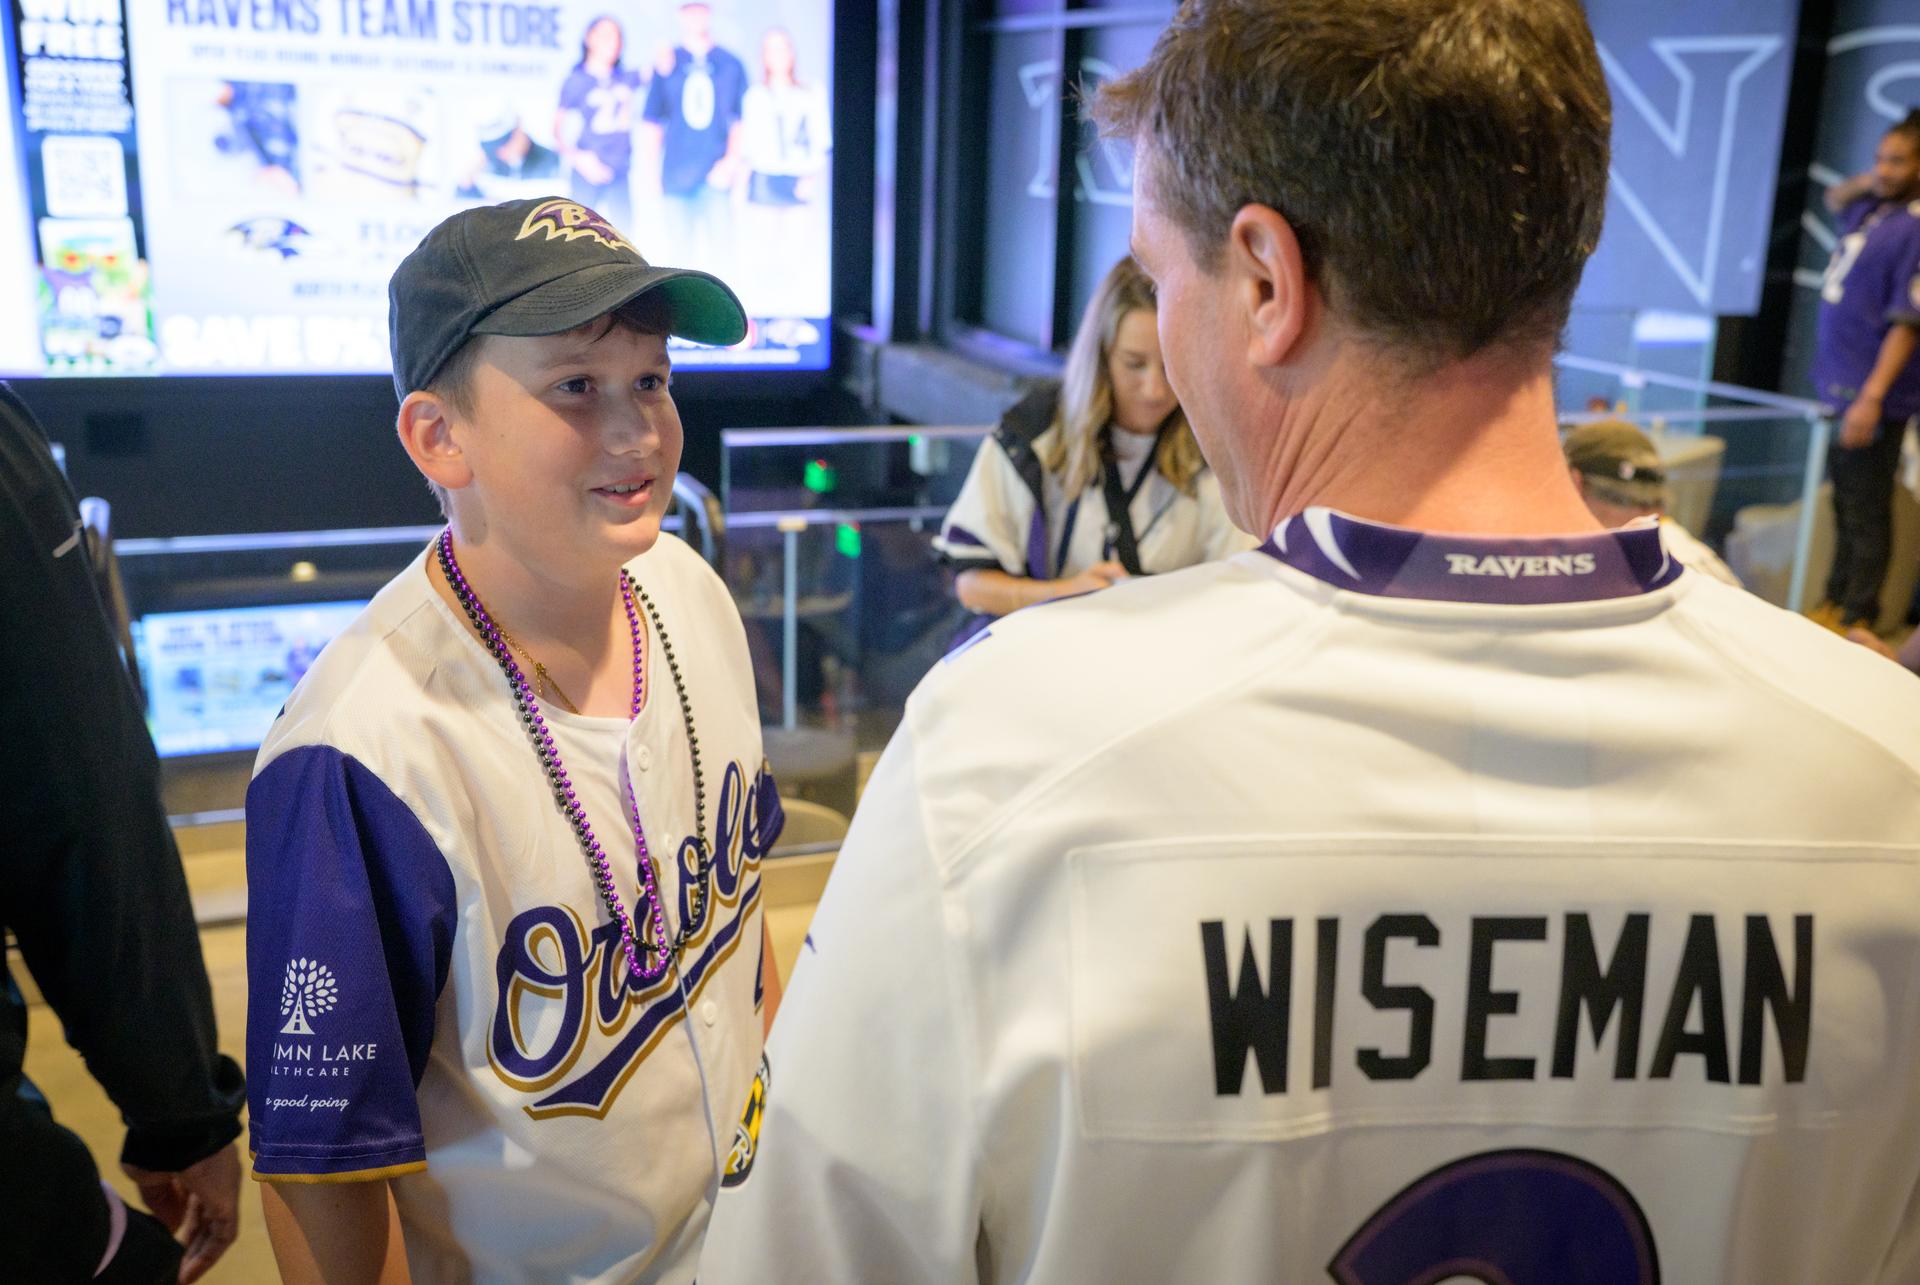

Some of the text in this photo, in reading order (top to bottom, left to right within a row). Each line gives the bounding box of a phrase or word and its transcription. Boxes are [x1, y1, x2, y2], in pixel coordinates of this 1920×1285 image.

[166, 0, 562, 49] RAVENS TEAM STORE
[1444, 553, 1597, 580] RAVENS
[1200, 913, 1813, 1096] WISEMAN
[273, 1042, 377, 1061] MN LAKE
[271, 1065, 350, 1077] LTHCARE
[273, 1094, 308, 1111] good
[310, 1097, 350, 1112] going
